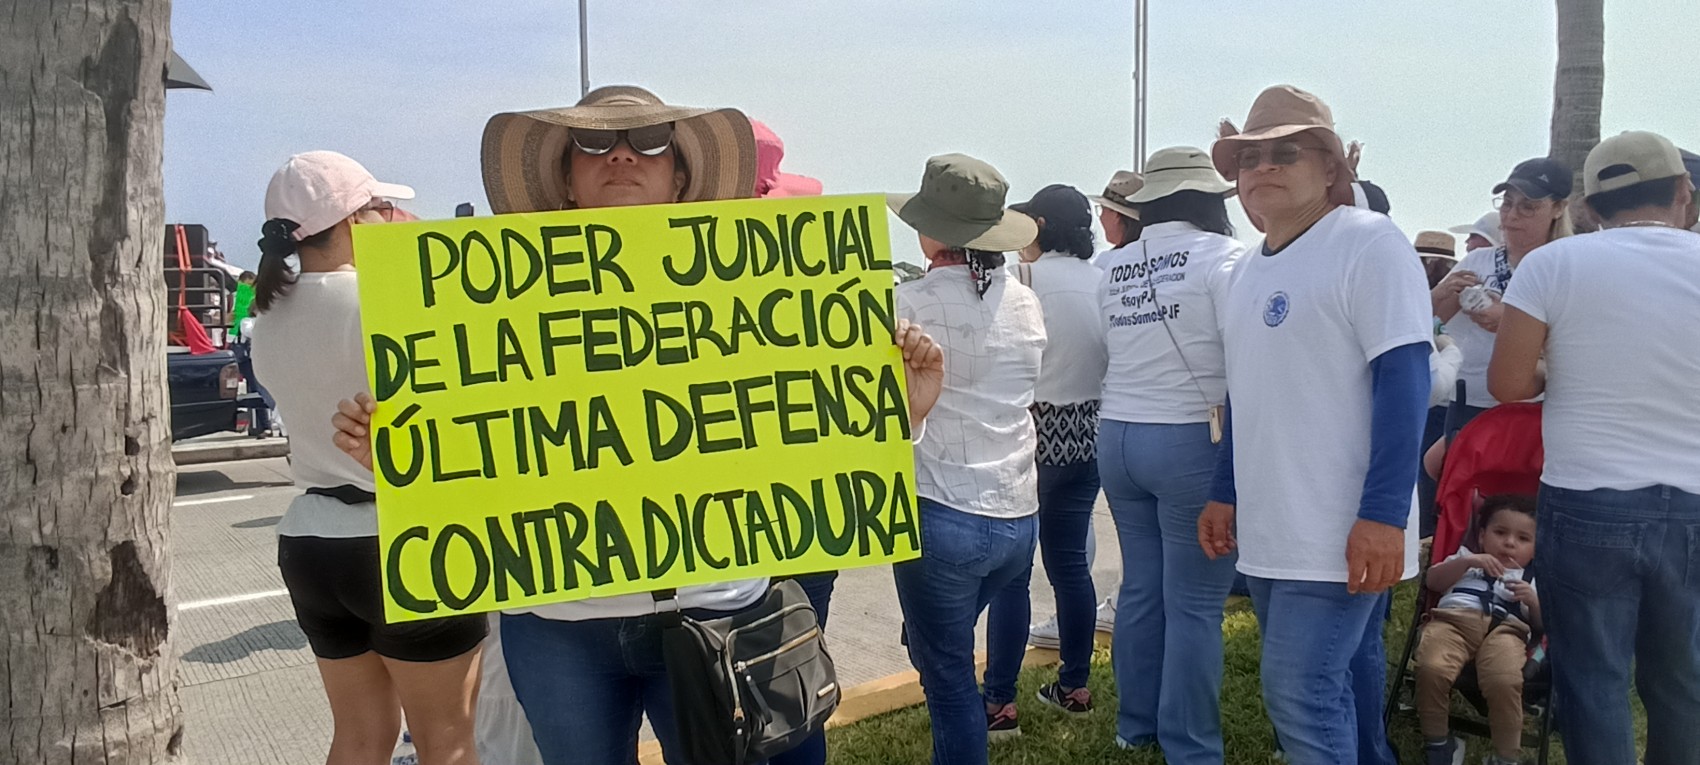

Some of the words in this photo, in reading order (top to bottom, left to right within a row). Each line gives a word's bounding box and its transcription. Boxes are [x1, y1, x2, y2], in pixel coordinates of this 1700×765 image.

[417, 224, 635, 308] PODER
[662, 206, 892, 287] JUDICIAL
[1109, 261, 1149, 284] TODOS
[1149, 251, 1189, 275] SOMOS
[371, 330, 447, 403] DE
[454, 318, 534, 387] LA
[538, 277, 897, 377] FEDERACIÓN
[376, 394, 634, 488] ÚLTIMA
[643, 364, 912, 463] DEFENSA
[387, 500, 640, 613] CONTRA
[642, 471, 920, 580] DICTADURA
